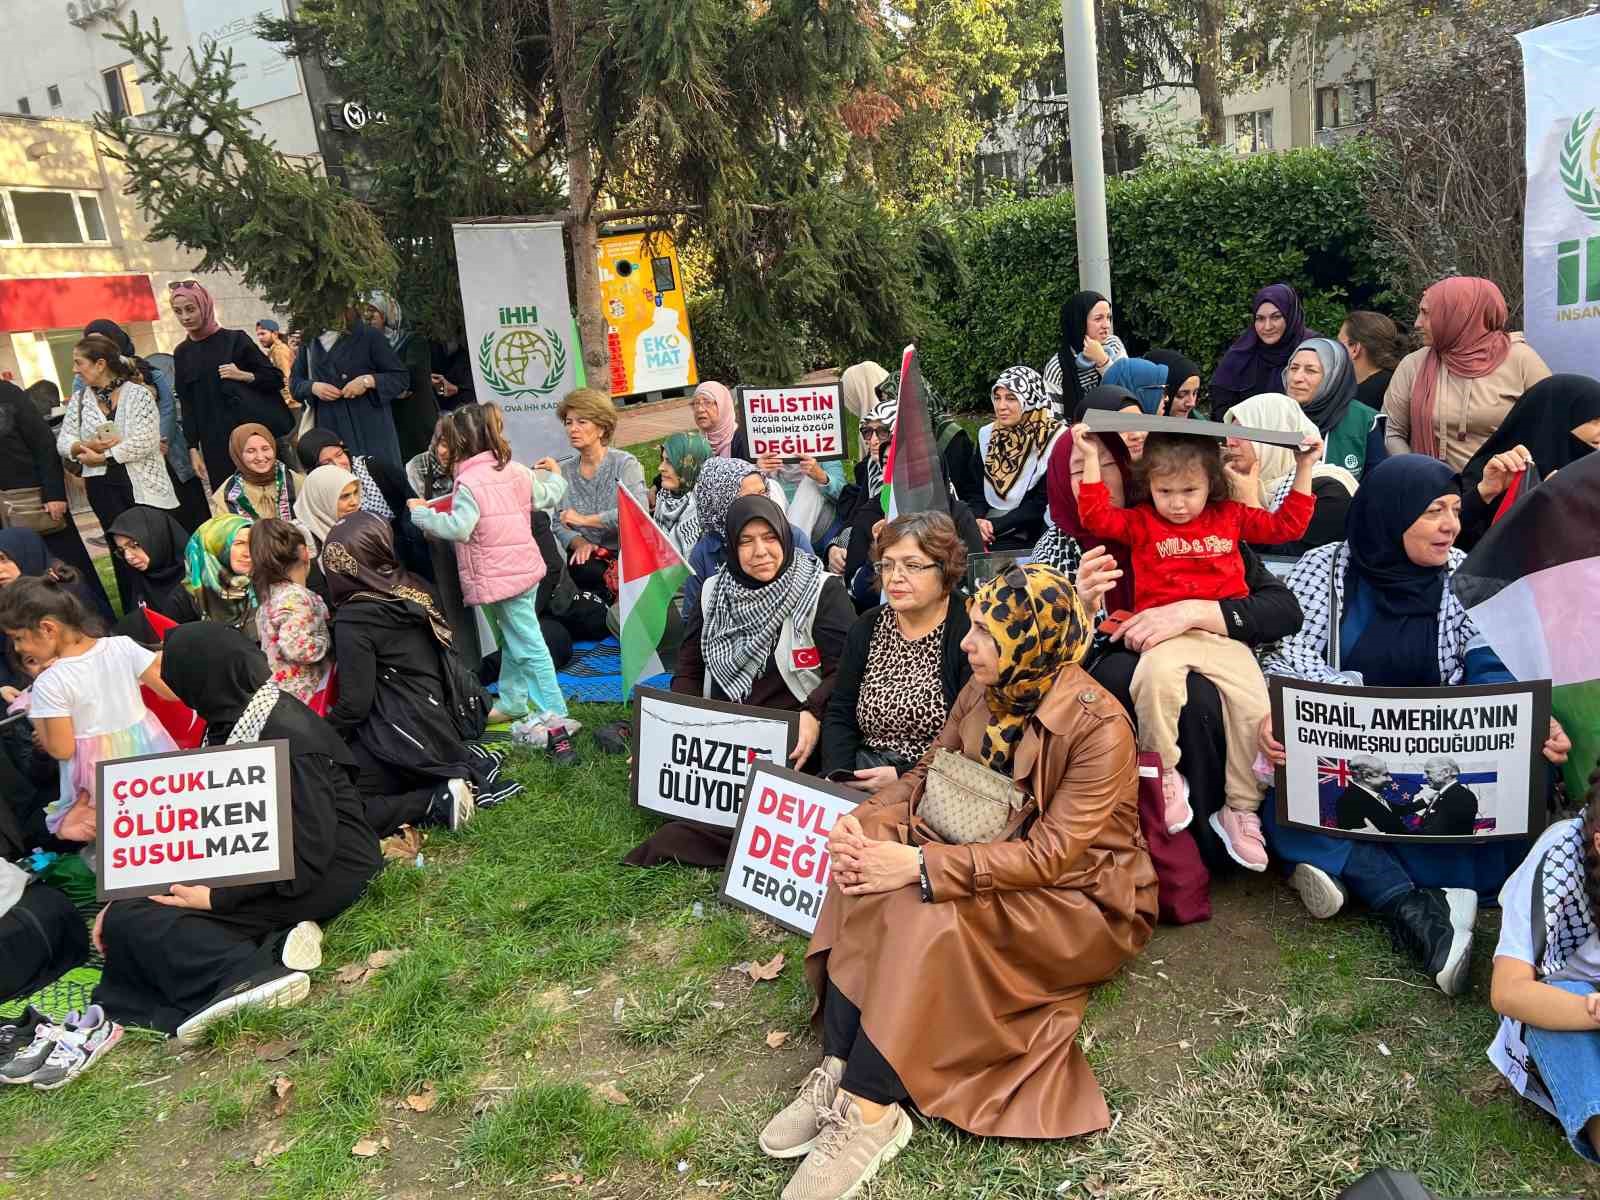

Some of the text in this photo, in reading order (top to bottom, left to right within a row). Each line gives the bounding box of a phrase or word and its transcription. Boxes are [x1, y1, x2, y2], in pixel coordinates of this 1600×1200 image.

[643, 334, 680, 352] EKO
[645, 350, 681, 368] MAT
[541, 402, 560, 411] KAD
[749, 391, 833, 414] FİLİSTİN
[751, 413, 833, 424] ÖZGÜR OLMADIKÇA
[802, 423, 834, 433] ÖZGÜR
[754, 433, 835, 455] DEĞİLİZ
[1155, 537, 1192, 558] WILD
[1192, 539, 1204, 553] &
[1295, 695, 1366, 732] İSRAİL,
[671, 733, 748, 777] GAZZE
[1298, 727, 1515, 756] GAYRİMEŞRU ÇOCUĞUDUR!
[112, 765, 267, 806] ÇOCUKLAR
[113, 799, 267, 839] ÖLÜRKEN
[757, 786, 845, 838] DEVL
[112, 831, 270, 869] SUSULMAZ
[747, 825, 833, 887] DEĞİ
[742, 864, 824, 919] TERÖRİ
